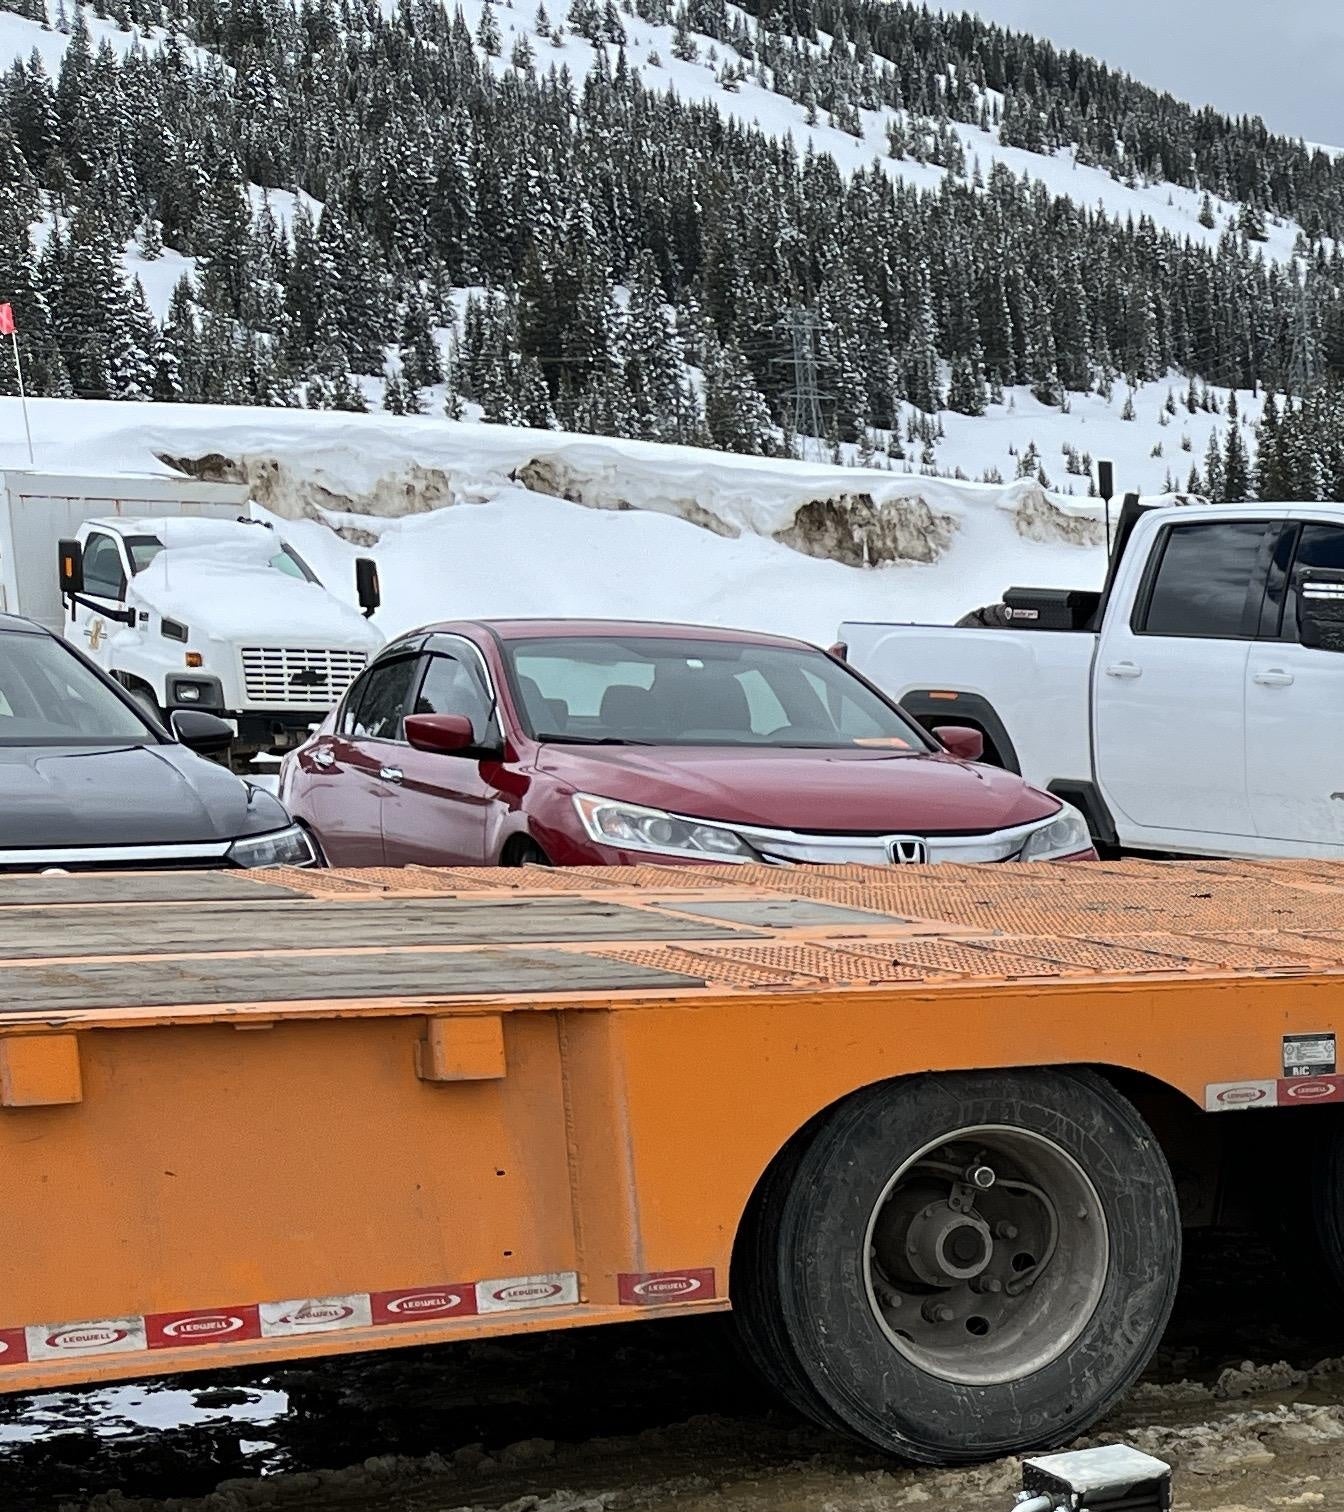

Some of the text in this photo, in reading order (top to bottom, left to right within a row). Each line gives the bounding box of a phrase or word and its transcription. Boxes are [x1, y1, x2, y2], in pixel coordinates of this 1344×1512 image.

[507, 1287, 549, 1298] LEDWELL
[648, 1282, 688, 1293] LEDWELL
[402, 1297, 447, 1310] LEDWELL
[180, 1317, 229, 1333] LEDWELL
[62, 1332, 112, 1345] LEDWELL
